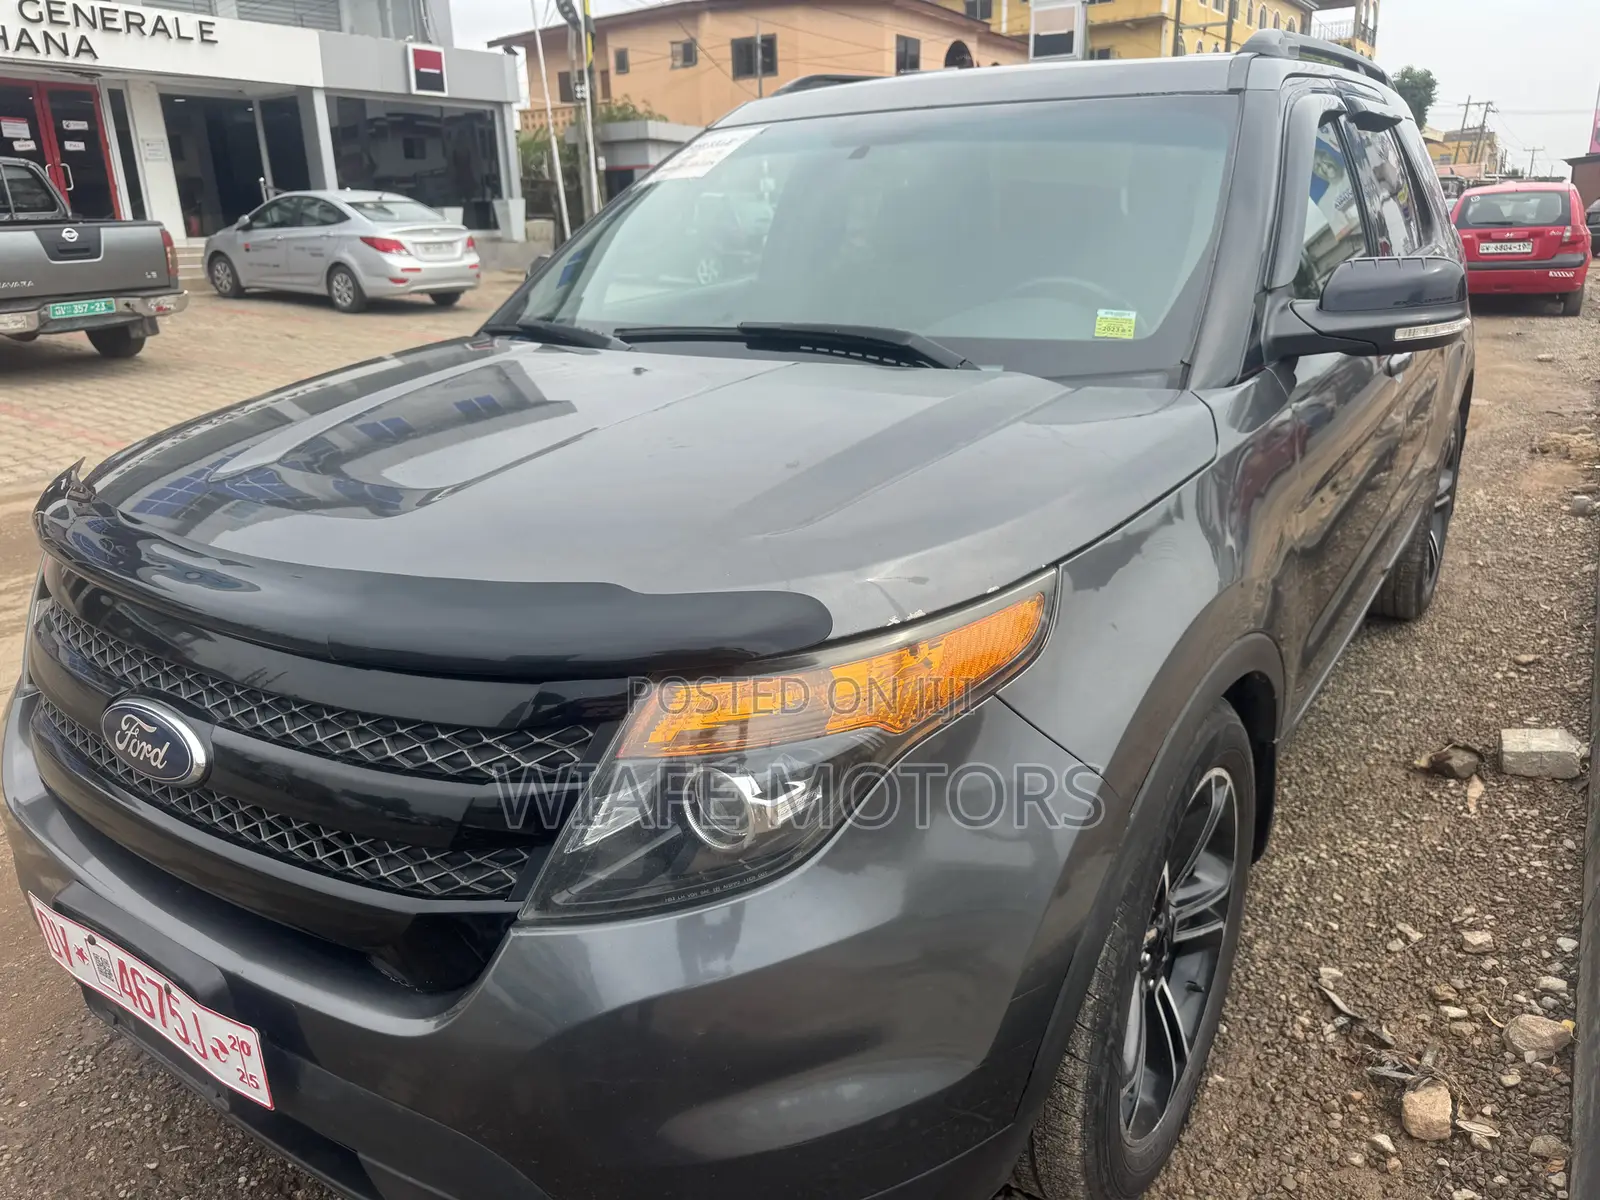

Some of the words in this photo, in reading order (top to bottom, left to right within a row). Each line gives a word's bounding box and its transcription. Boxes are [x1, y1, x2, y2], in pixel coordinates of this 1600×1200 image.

[17, 0, 218, 44] GENERALE
[115, 714, 170, 769] Ford
[37, 907, 74, 968] DV
[227, 1034, 252, 1057] 20
[235, 1067, 260, 1090] 25
